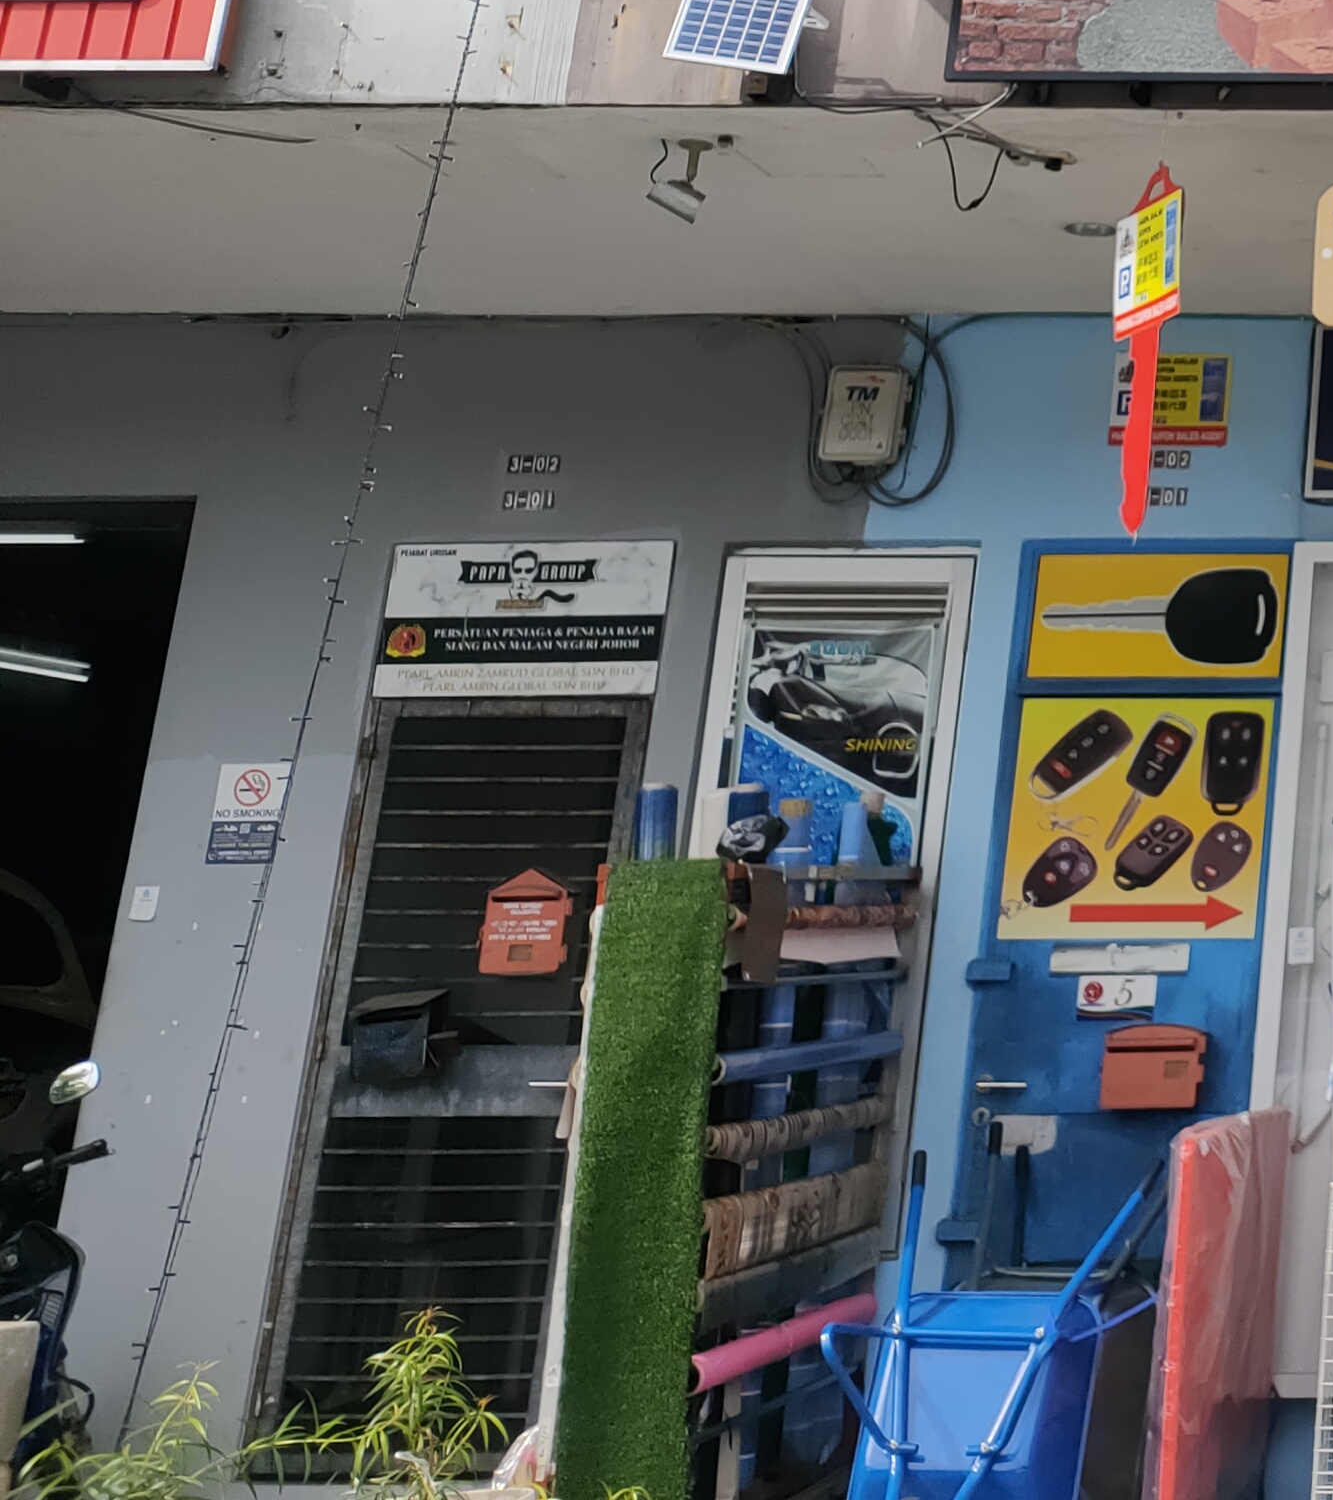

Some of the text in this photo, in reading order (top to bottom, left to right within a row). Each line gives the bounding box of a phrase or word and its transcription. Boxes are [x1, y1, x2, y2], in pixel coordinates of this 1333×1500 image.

[846, 386, 880, 402] TM
[469, 564, 587, 581] PAPA GROUP
[434, 627, 500, 639] PERSATUAN
[502, 627, 552, 639] PENIAGA
[554, 627, 564, 639] &
[616, 626, 656, 637] BAZAR
[444, 639, 640, 652] SIANG DAN MALAM NEGERI JOHOR
[581, 667, 605, 677] SDN
[551, 681, 577, 691] SDN
[845, 738, 917, 753] SHINING
[215, 808, 281, 819] NO SMOKING
[1114, 977, 1135, 1007] 5
